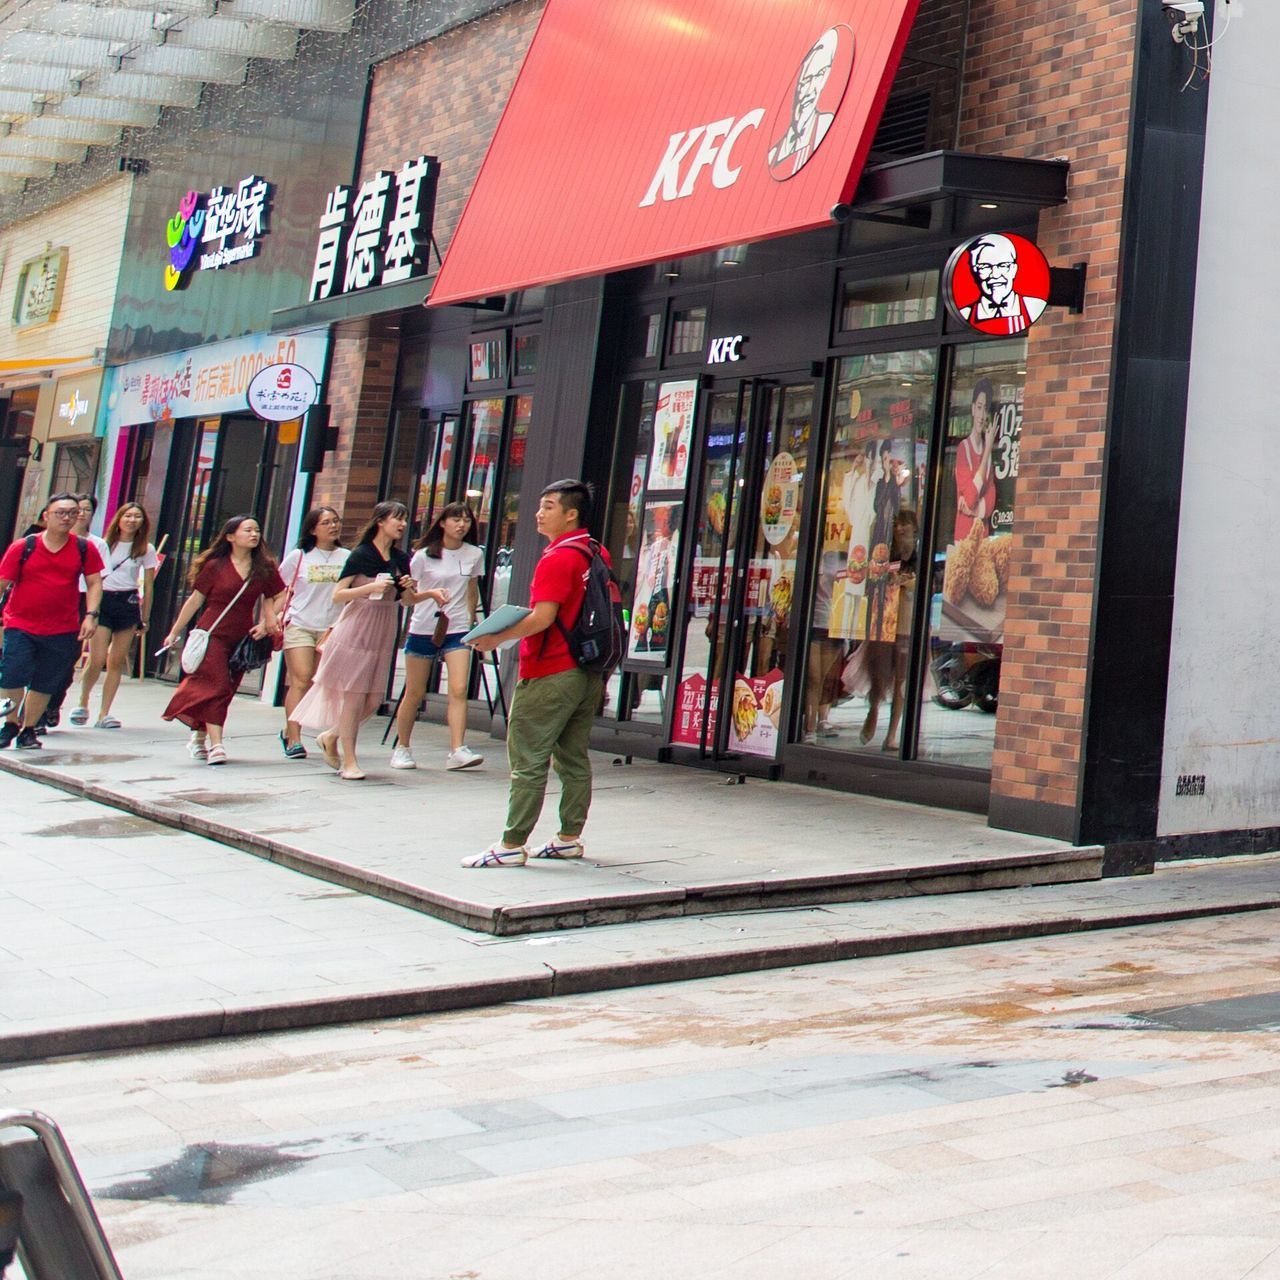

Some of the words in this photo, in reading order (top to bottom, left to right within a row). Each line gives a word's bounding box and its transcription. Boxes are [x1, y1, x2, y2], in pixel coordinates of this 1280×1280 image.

[638, 107, 766, 208] KFC
[309, 156, 438, 302] 肯德基
[707, 335, 743, 364] KFC
